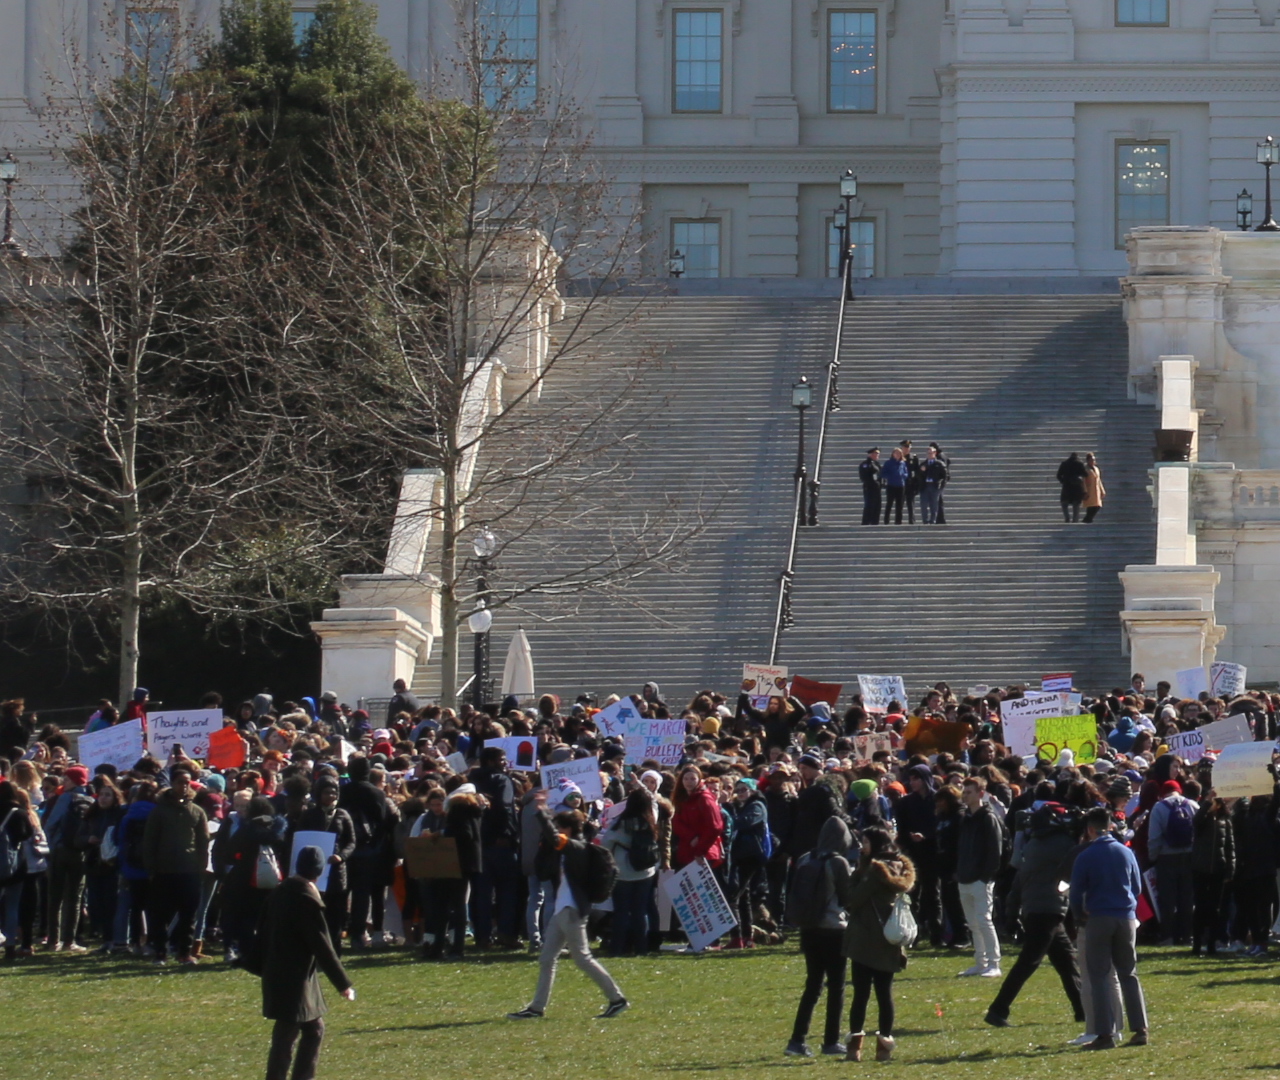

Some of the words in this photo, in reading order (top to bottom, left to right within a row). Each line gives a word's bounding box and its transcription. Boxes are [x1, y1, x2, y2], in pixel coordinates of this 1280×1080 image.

[745, 664, 781, 675] Remember
[860, 676, 886, 685] PROTECT
[867, 686, 881, 694] NOT
[886, 686, 895, 695] UR
[869, 696, 887, 705] NRA
[1011, 698, 1029, 710] AND
[151, 716, 189, 731] Thoughts
[191, 718, 209, 727] and
[627, 722, 647, 735] WE
[649, 721, 685, 735] MARCH
[644, 736, 661, 746] THE
[1182, 732, 1203, 747] KIDS
[645, 744, 684, 757] BULLETS
[672, 894, 683, 905] I
[677, 880, 689, 896] WHEN
[685, 896, 699, 918] BUYING
[697, 870, 705, 879] AT
[702, 881, 710, 891] THE
[707, 892, 721, 913] MOVIES
[717, 914, 725, 924] BUT
[699, 892, 715, 914] KNOW
[676, 904, 691, 921] AM
[691, 892, 699, 902] NOT
[696, 903, 704, 913] GET
[701, 914, 713, 931] ASKED
